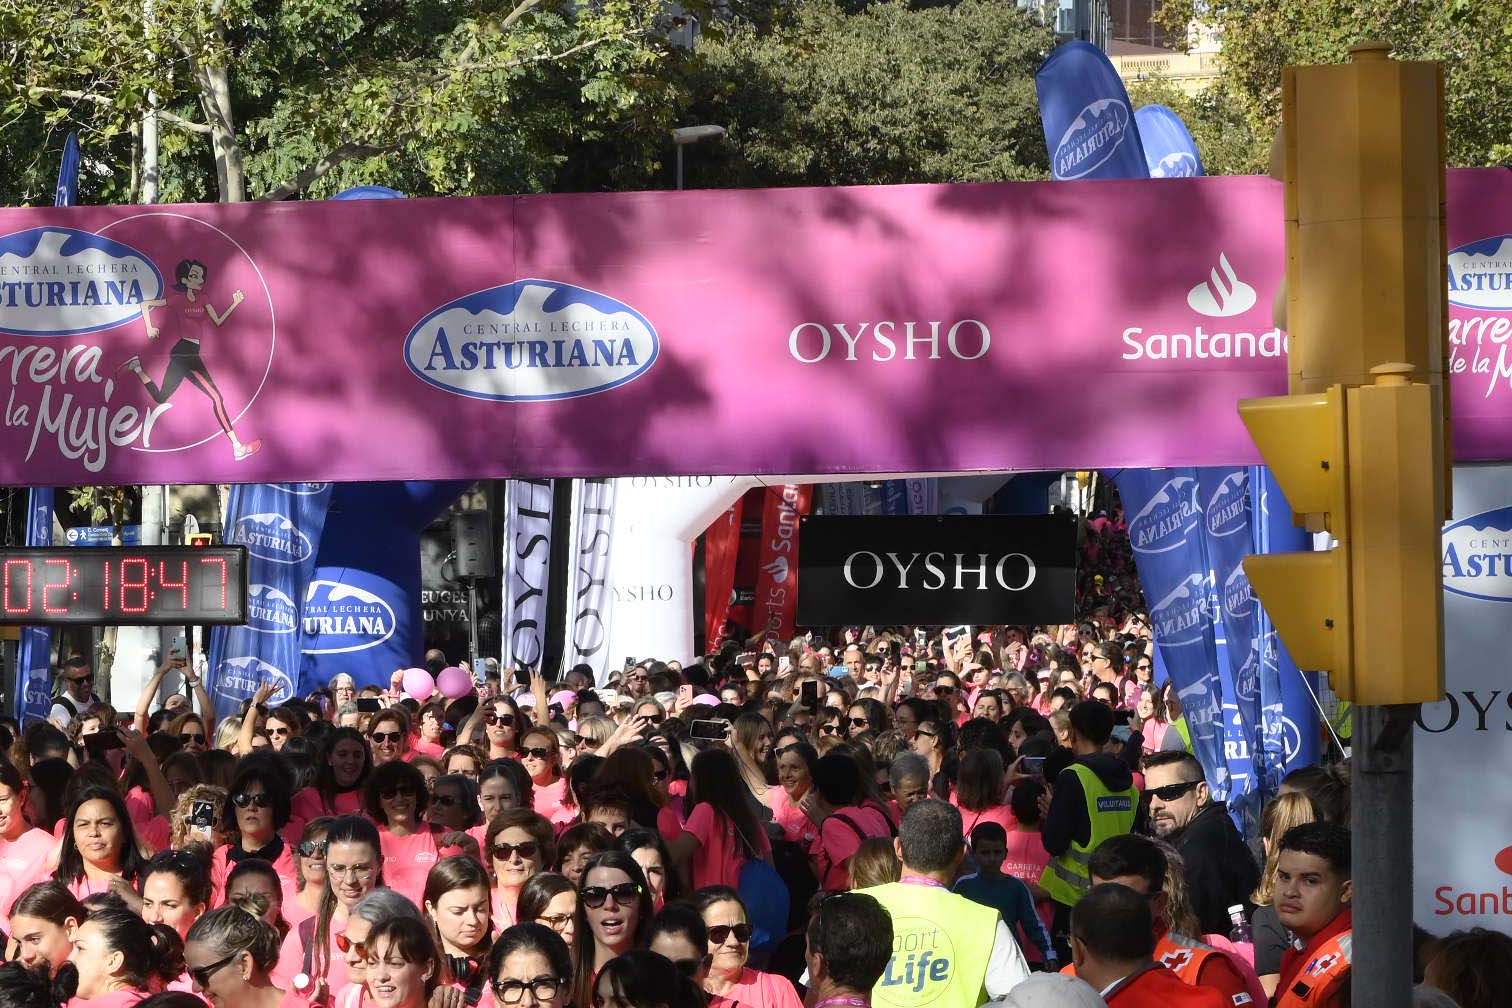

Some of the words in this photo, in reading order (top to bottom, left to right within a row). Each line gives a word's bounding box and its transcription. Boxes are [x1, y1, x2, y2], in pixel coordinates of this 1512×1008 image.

[66, 263, 139, 275] LECHERA
[463, 322, 541, 335] CENTRAL
[550, 320, 630, 333] LECHERA
[788, 318, 991, 364] OYSHO
[423, 326, 639, 371] ASTURIANA
[1472, 347, 1489, 373] la
[5, 386, 30, 426] la
[25, 377, 172, 473] Mujer
[771, 484, 800, 553] Santa
[238, 525, 302, 558] ASTURIANA
[4, 558, 227, 614] 02:18:47
[844, 550, 1037, 592] OYSHO
[333, 605, 381, 613] LECHERA
[612, 584, 673, 602] YSHO
[249, 606, 294, 627] URIANA
[424, 609, 469, 622] UNYA
[881, 951, 950, 992] Life
